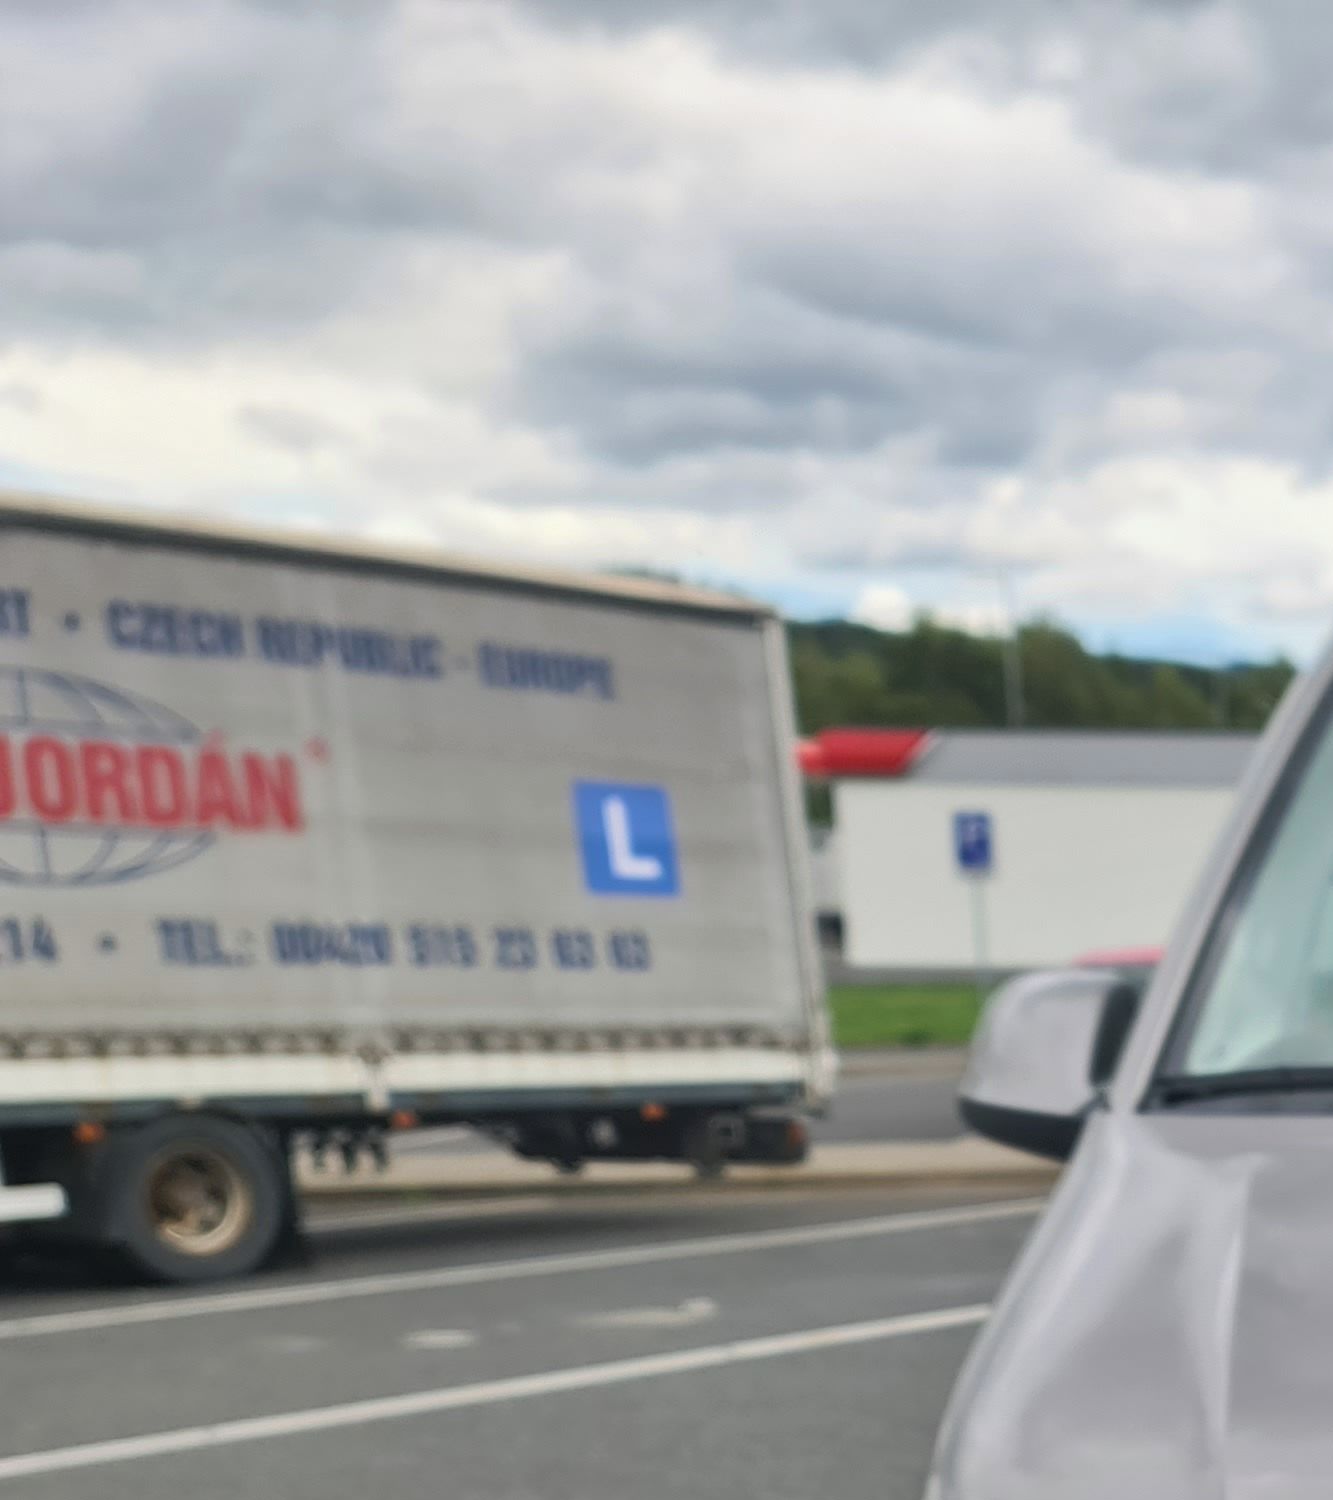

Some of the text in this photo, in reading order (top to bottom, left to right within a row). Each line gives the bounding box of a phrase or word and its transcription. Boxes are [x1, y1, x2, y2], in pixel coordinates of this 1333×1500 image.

[107, 600, 244, 658] CZECH
[255, 615, 442, 678] REPUBLIC
[477, 638, 613, 699] EUROPE
[602, 795, 662, 880] L
